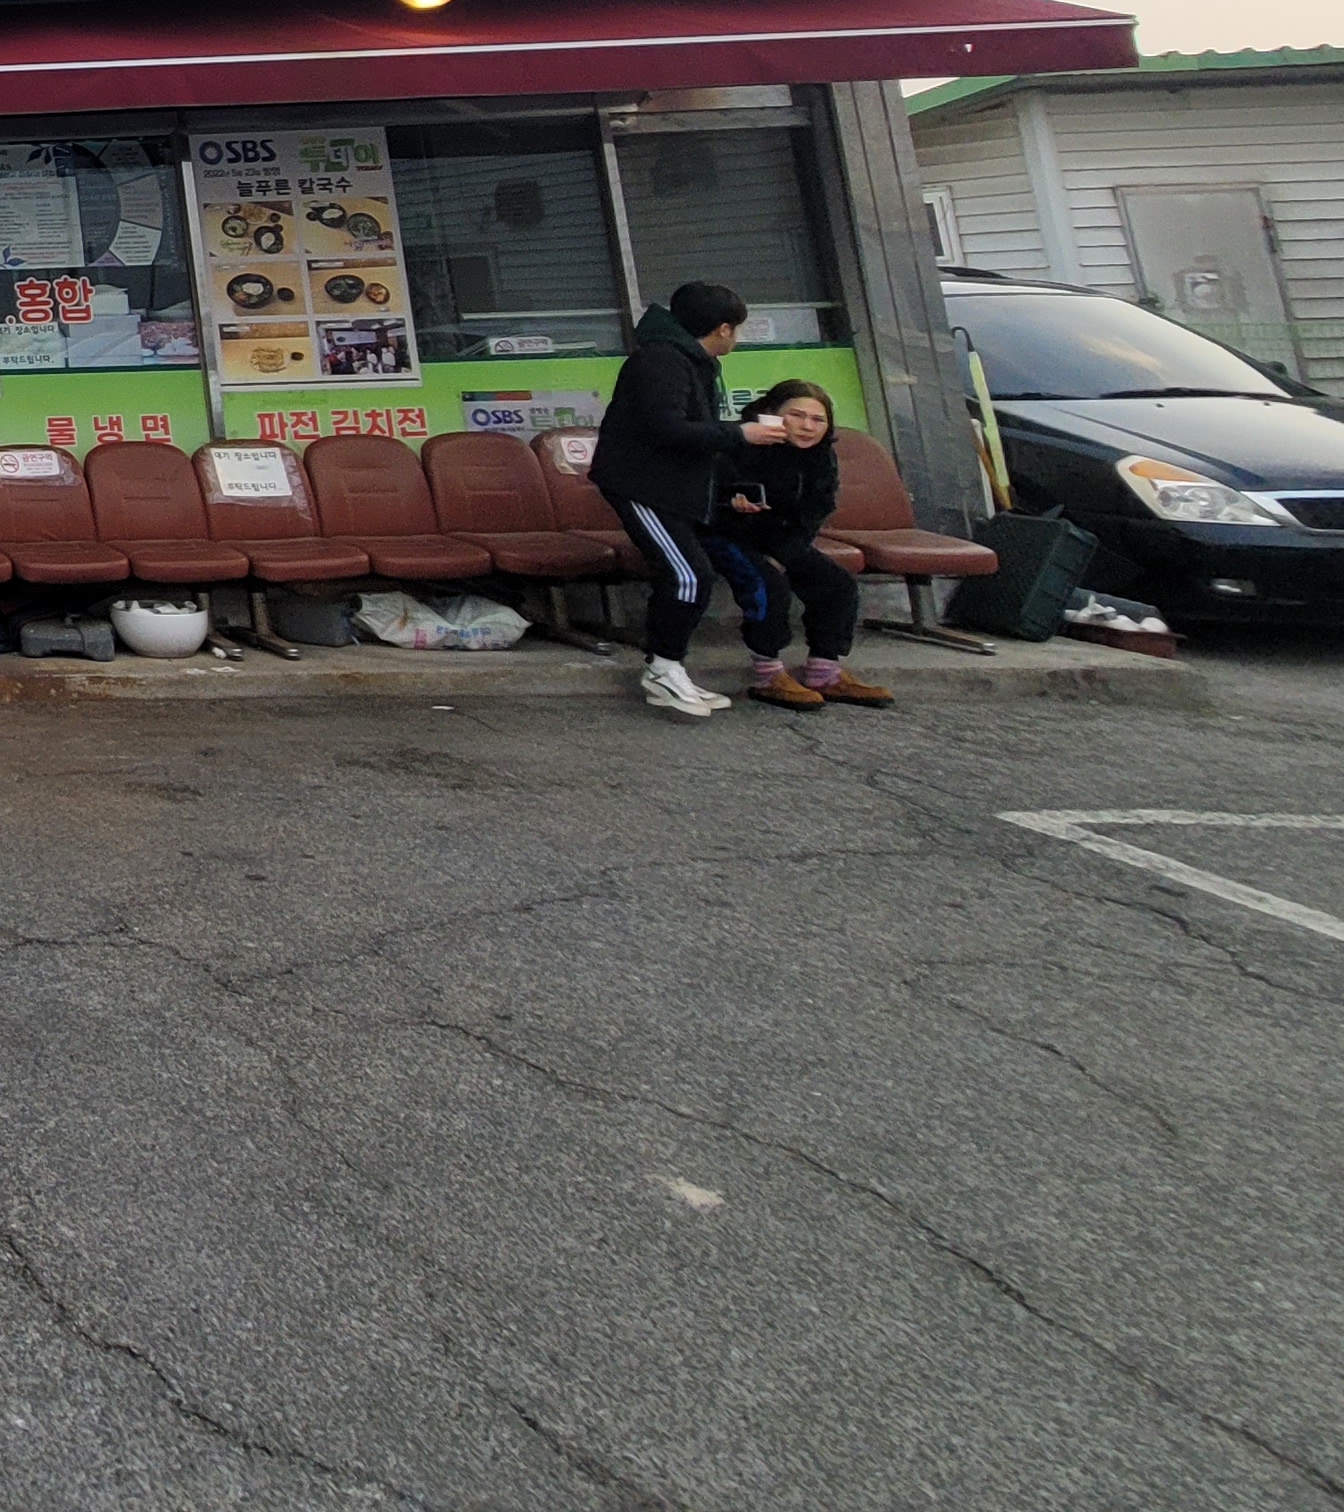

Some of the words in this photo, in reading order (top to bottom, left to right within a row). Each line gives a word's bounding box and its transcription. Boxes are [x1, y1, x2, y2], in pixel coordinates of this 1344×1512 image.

[224, 139, 277, 164] SBS
[236, 178, 291, 197] 늘푸른
[298, 176, 353, 195] 칼국수
[15, 325, 55, 335] 장소입니다
[256, 409, 321, 441] 파전
[330, 407, 429, 439] 김치전
[490, 409, 524, 425] SBS
[46, 414, 173, 447] 물냉면
[234, 451, 277, 461] 장소입니다
